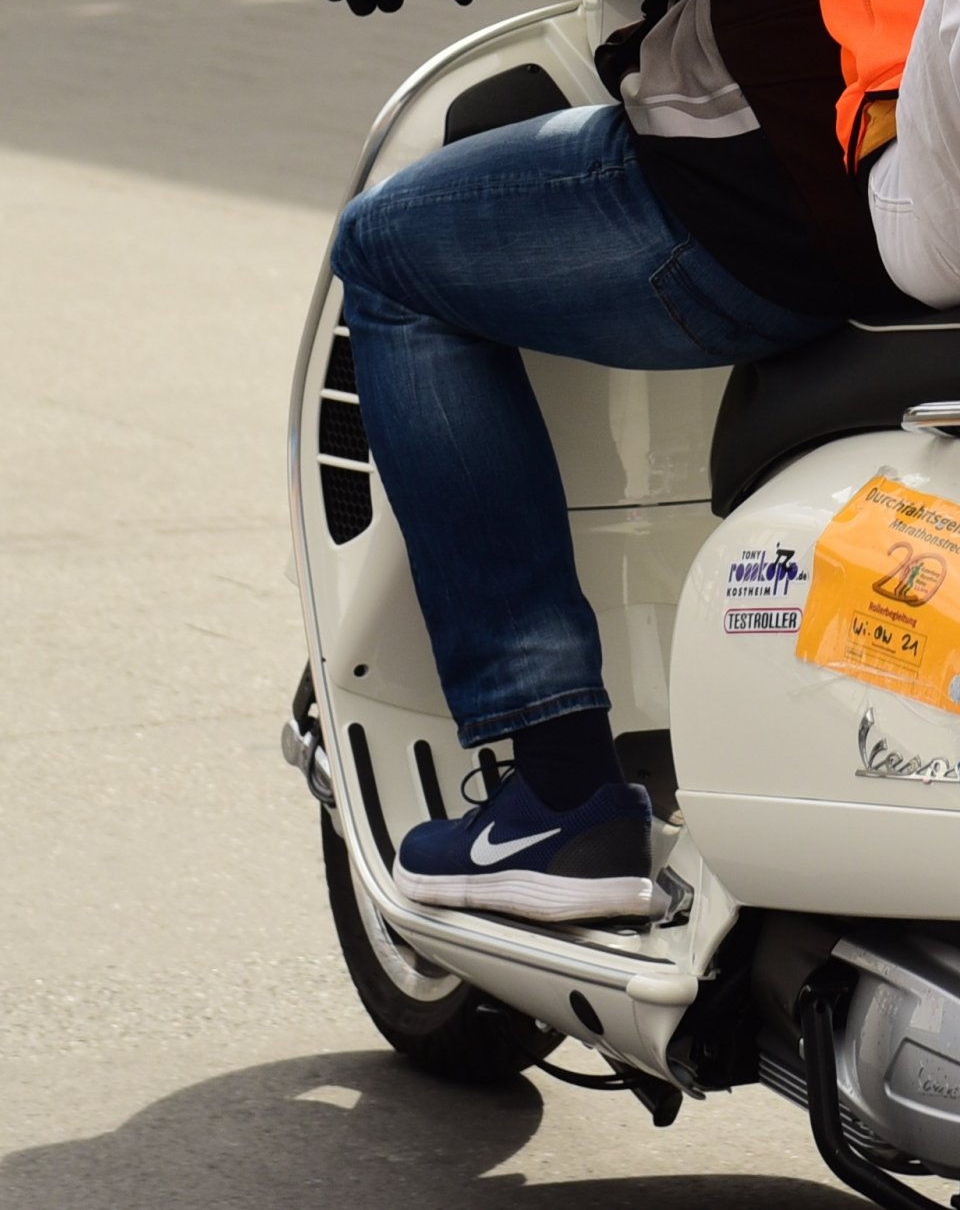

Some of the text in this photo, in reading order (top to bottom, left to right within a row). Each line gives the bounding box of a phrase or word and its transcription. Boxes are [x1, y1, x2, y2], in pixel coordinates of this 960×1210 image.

[741, 550, 761, 560] TONY
[726, 586, 771, 597] KOSTHEIM
[728, 612, 798, 630] TESTROLLER
